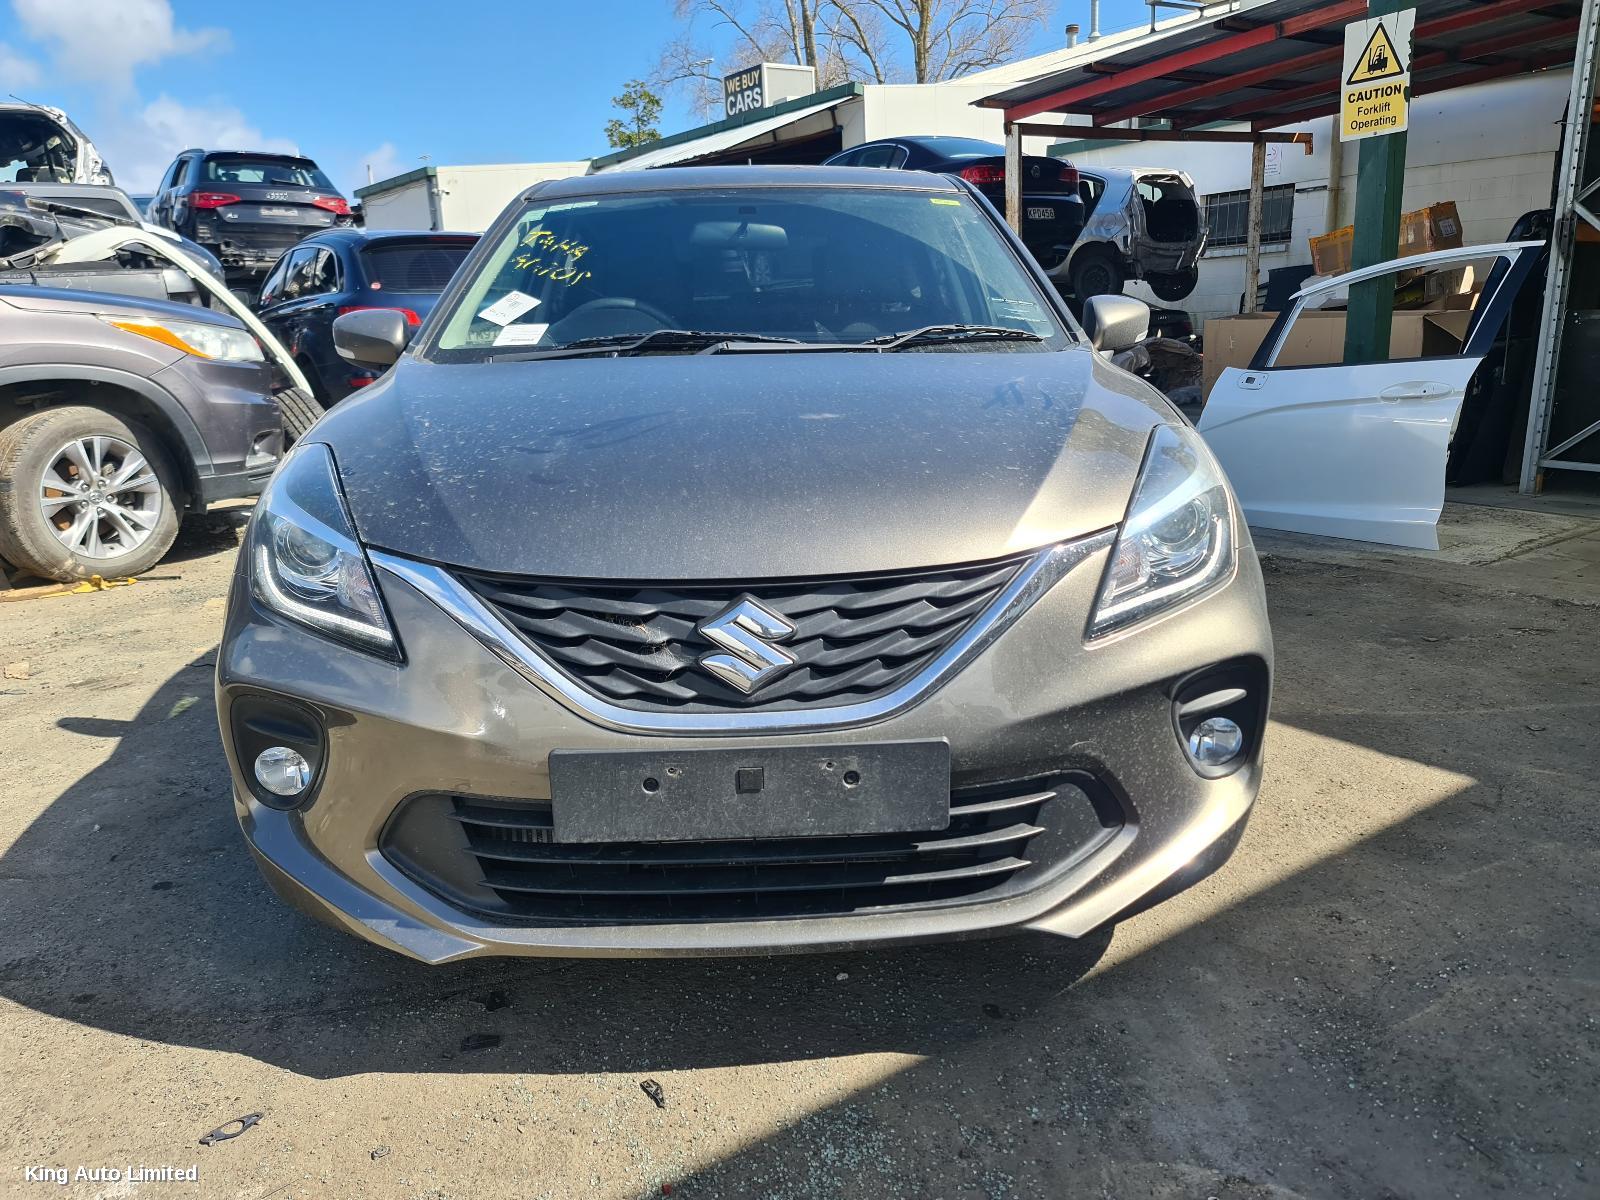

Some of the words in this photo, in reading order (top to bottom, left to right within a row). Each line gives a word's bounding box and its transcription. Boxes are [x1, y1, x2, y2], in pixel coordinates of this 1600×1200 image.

[727, 77, 740, 94] WE
[742, 70, 760, 89] BUY
[727, 88, 762, 115] CARS
[1348, 84, 1402, 103] CAUTION
[1357, 101, 1390, 117] Forklift
[1350, 115, 1397, 131] Operating
